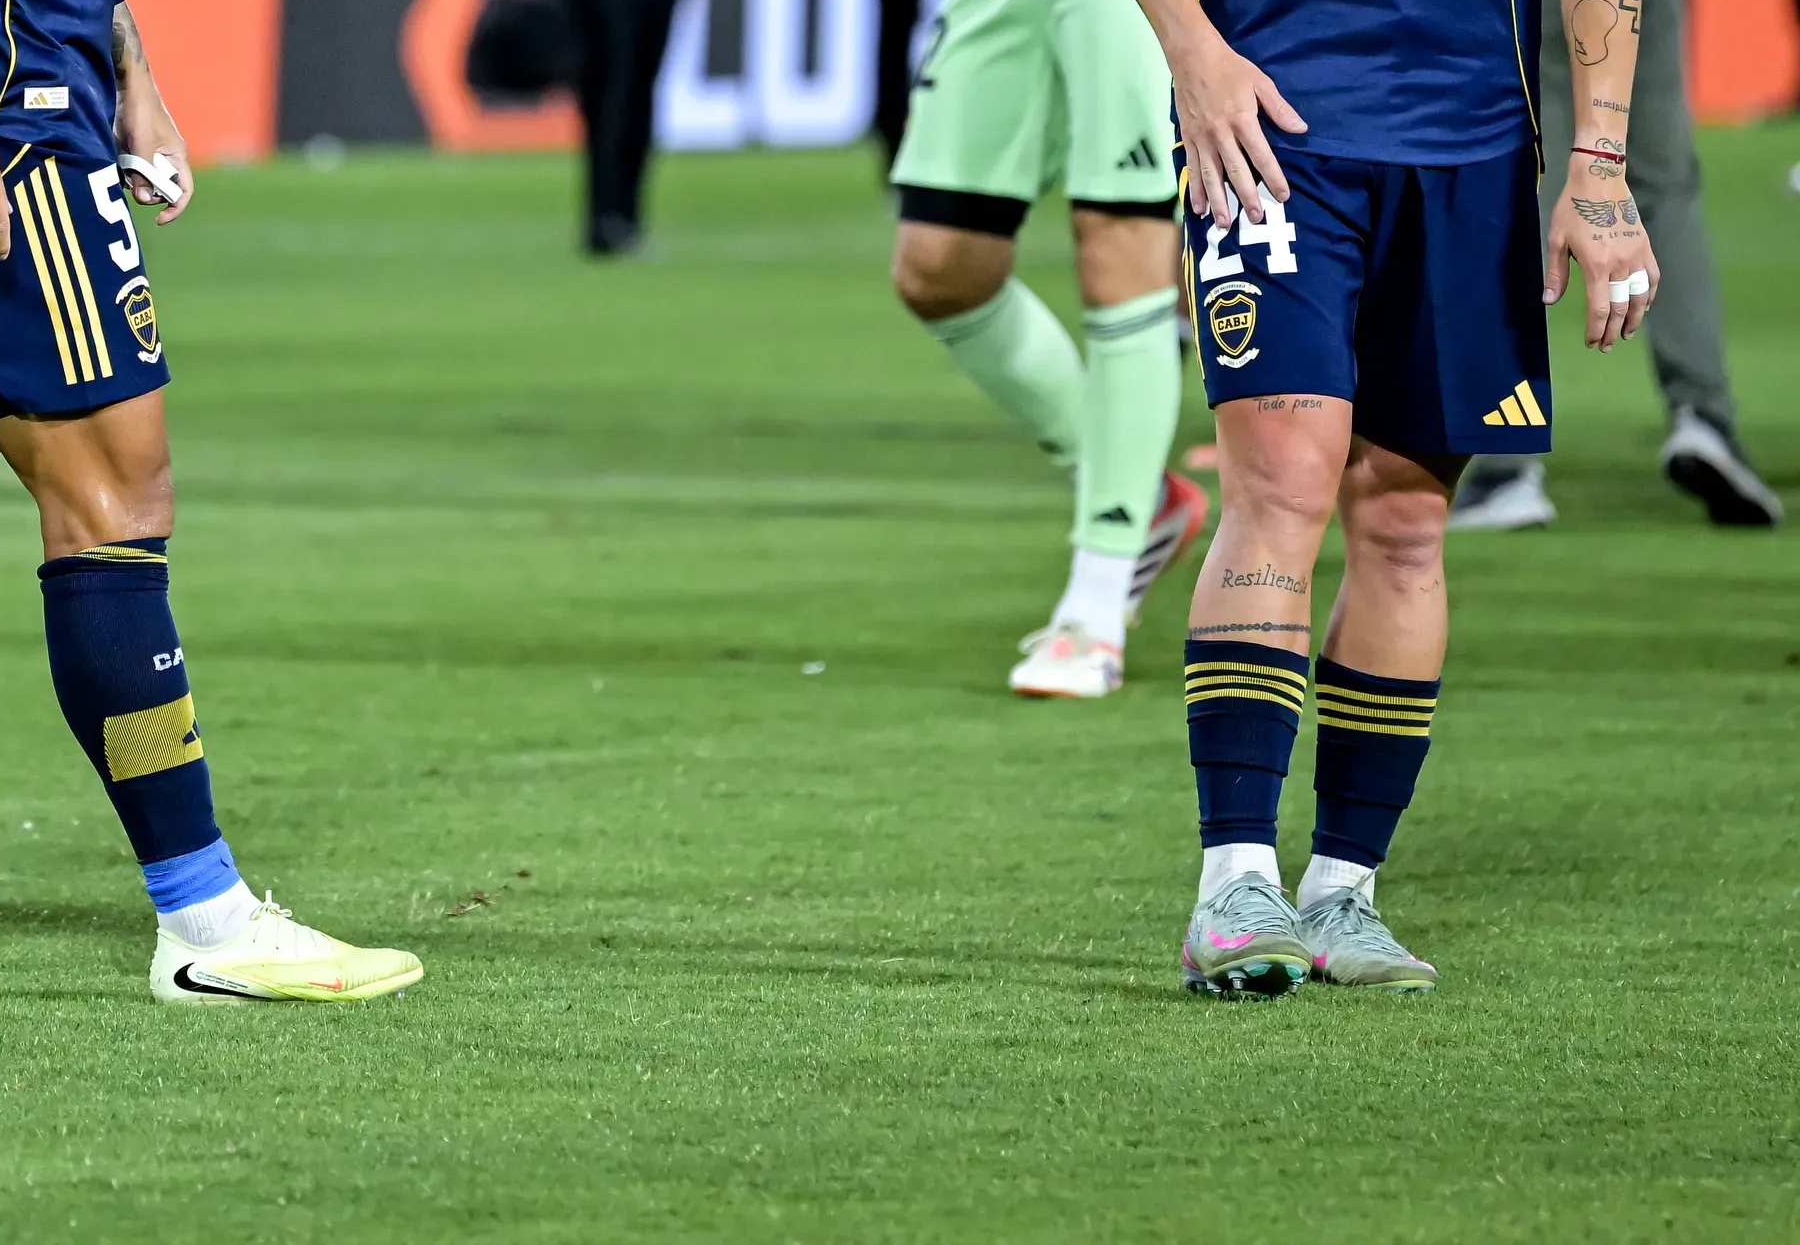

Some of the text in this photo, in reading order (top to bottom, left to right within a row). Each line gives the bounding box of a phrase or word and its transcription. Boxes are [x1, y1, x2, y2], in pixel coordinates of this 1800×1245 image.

[87, 163, 142, 273] 5
[1217, 315, 1249, 332] CABJ
[1254, 396, 1324, 414] Todo pasa
